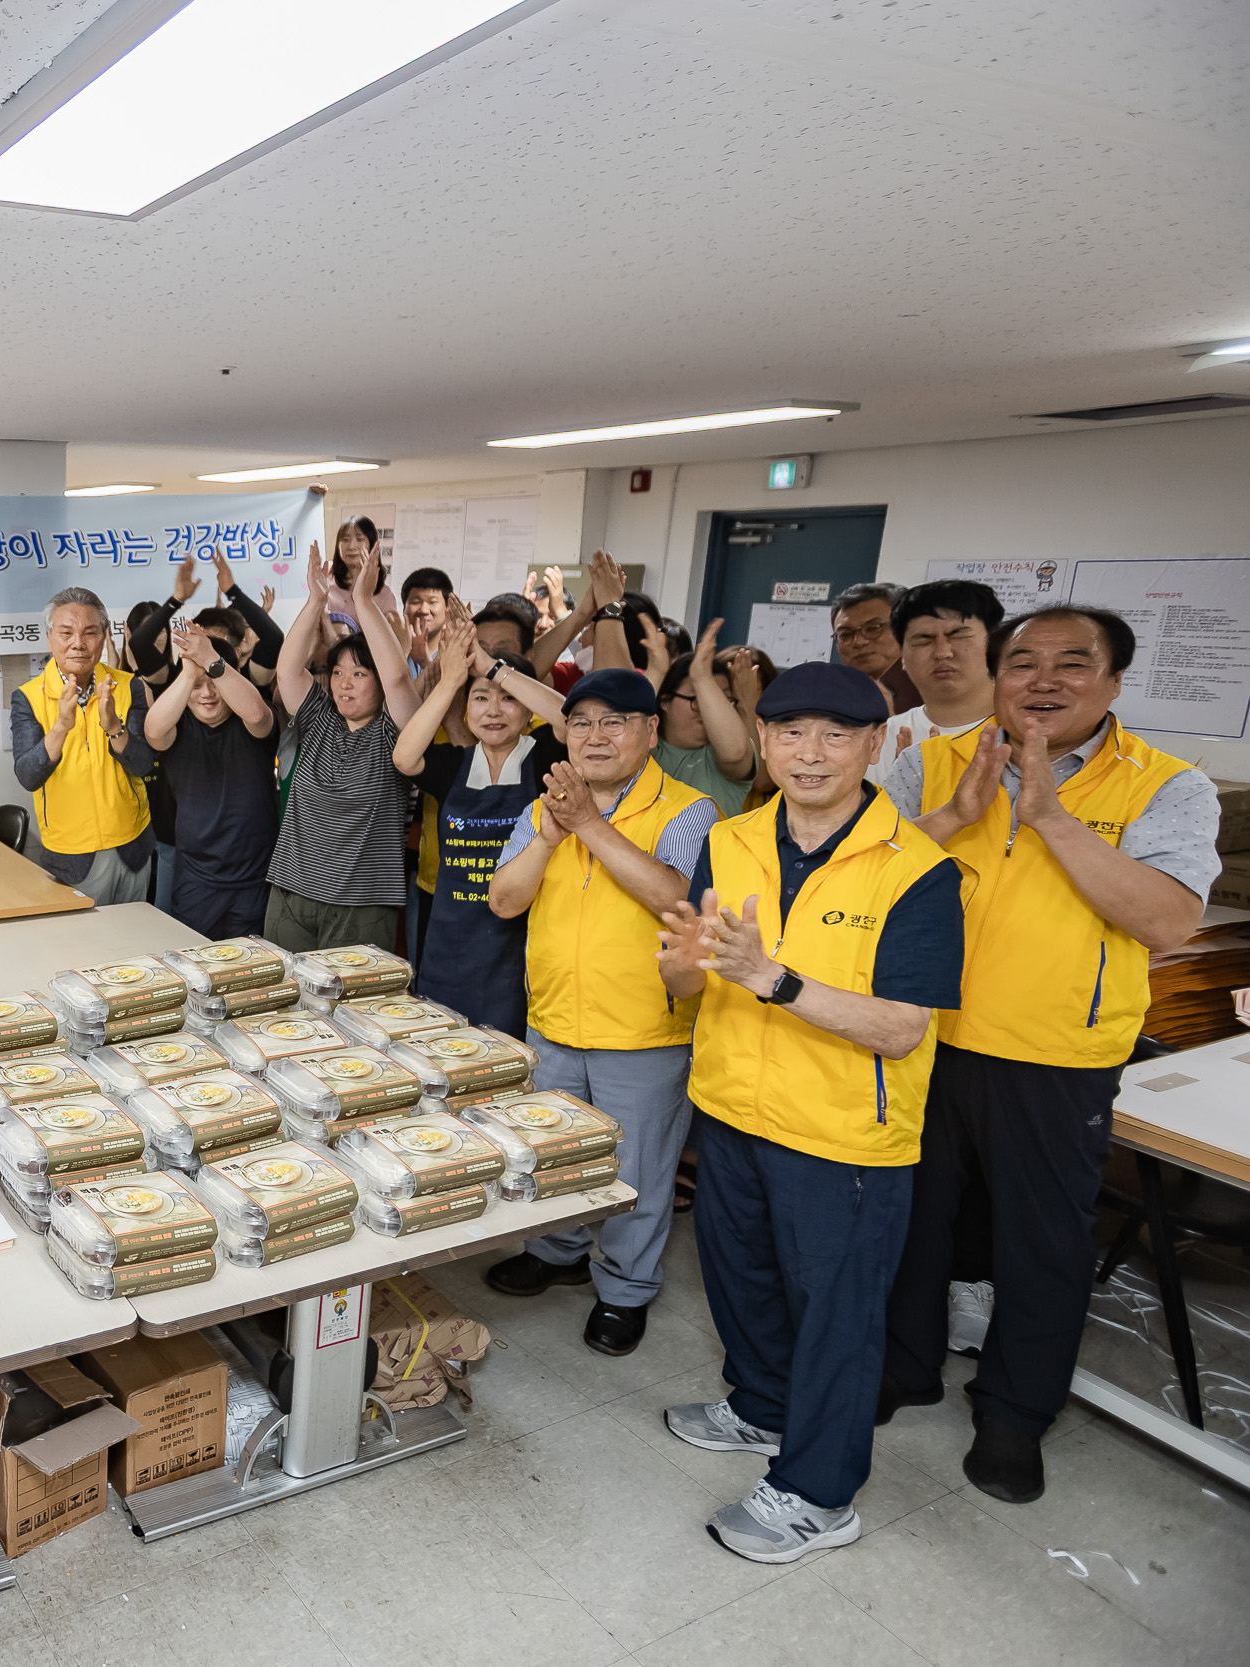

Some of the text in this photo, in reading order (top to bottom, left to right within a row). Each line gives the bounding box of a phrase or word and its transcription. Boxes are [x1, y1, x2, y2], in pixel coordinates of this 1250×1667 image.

[51, 528, 155, 566] 자라는
[163, 520, 295, 563] 건강밥상」
[991, 561, 1035, 574] 안전수칙
[452, 857, 477, 868] 쇼핑백
[789, 1517, 821, 1542] N
